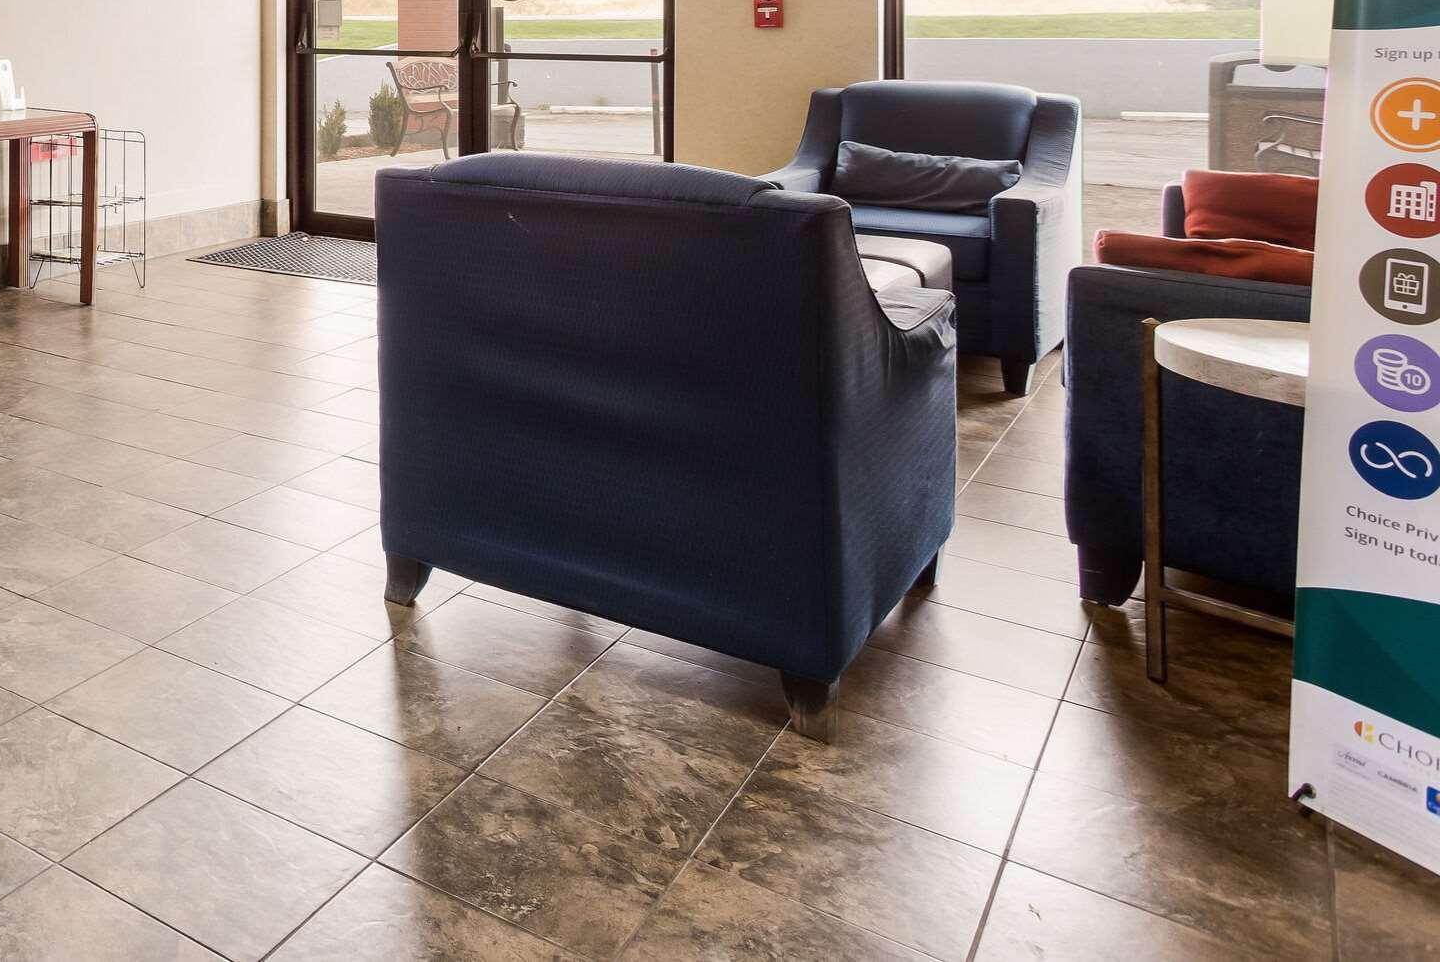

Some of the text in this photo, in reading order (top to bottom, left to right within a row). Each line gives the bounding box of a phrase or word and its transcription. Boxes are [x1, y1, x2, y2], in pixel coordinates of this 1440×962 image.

[1374, 47, 1408, 62] Sign
[1412, 51, 1433, 63] up
[1404, 372, 1422, 388] 10
[1346, 505, 1440, 543] Choice Priv
[1344, 526, 1440, 567] Sign up tod
